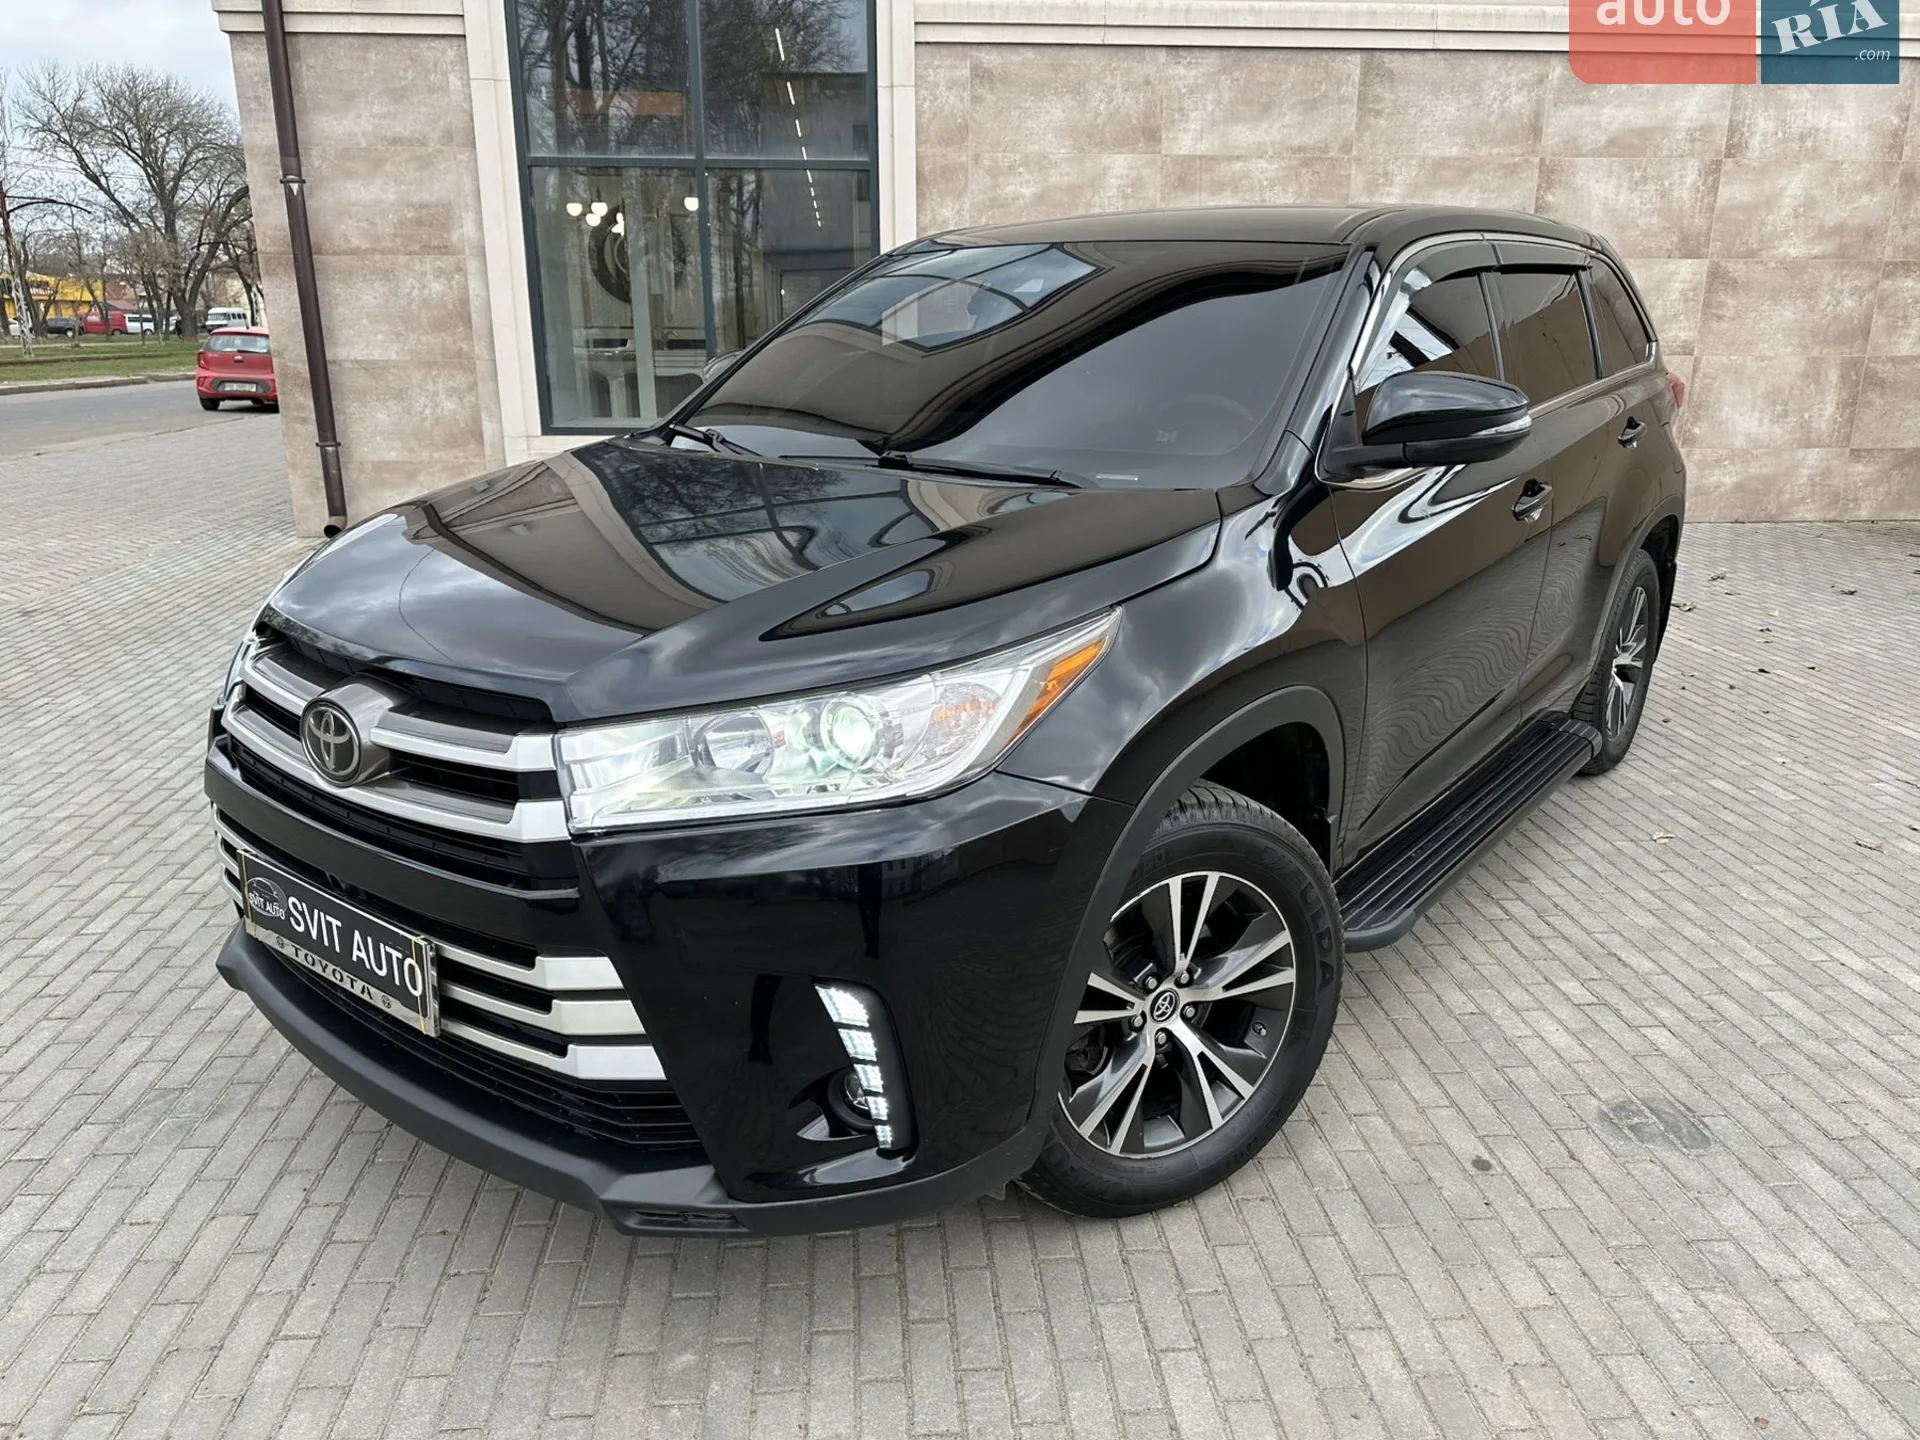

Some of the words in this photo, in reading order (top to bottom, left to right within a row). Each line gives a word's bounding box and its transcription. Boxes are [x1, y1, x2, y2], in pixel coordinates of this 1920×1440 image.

[266, 901, 285, 920] AUTO
[287, 896, 342, 953] SVIT
[352, 930, 424, 997] AUTO
[290, 945, 374, 1000] TOYOTA
